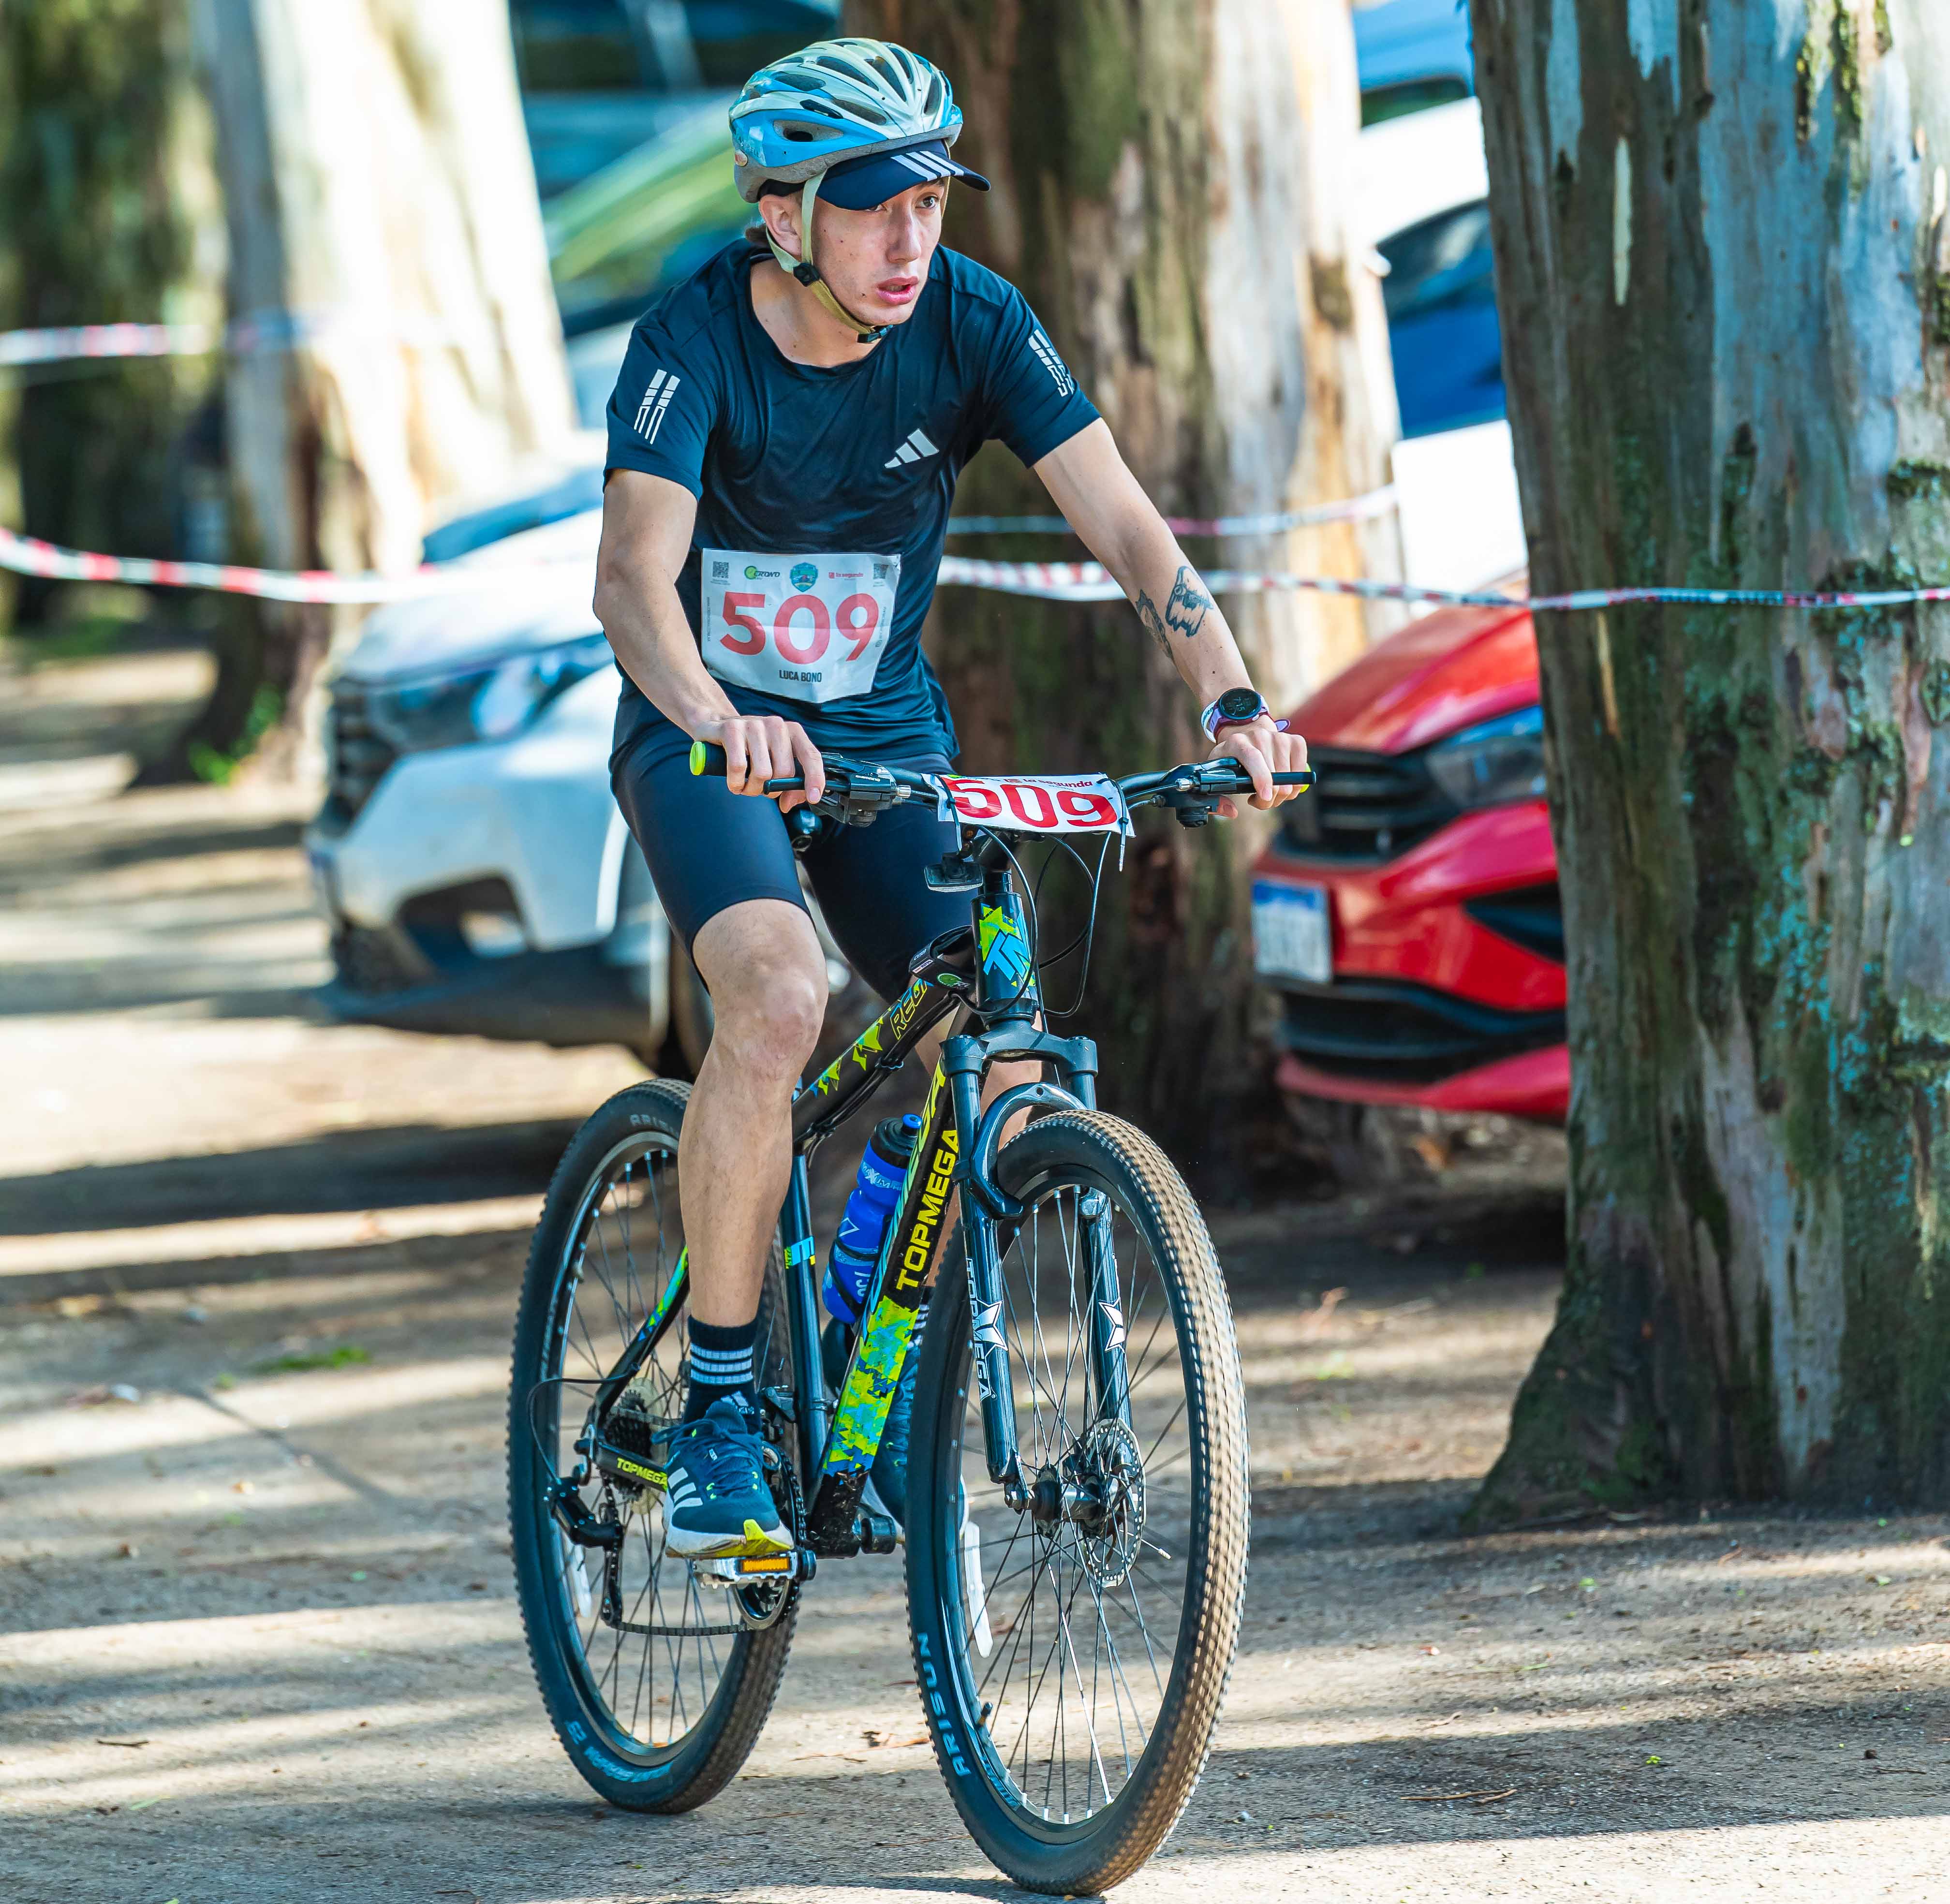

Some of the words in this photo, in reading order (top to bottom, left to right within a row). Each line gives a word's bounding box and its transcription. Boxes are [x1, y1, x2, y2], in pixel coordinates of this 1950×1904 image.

[720, 592, 879, 664] 509
[779, 670, 799, 681] LUCA
[801, 672, 822, 682] BONO
[942, 777, 1117, 827] 509
[896, 1130, 959, 1290] TOPMEGA
[617, 1457, 667, 1486] TOPMEGA
[917, 1633, 971, 1777] ARISUN
